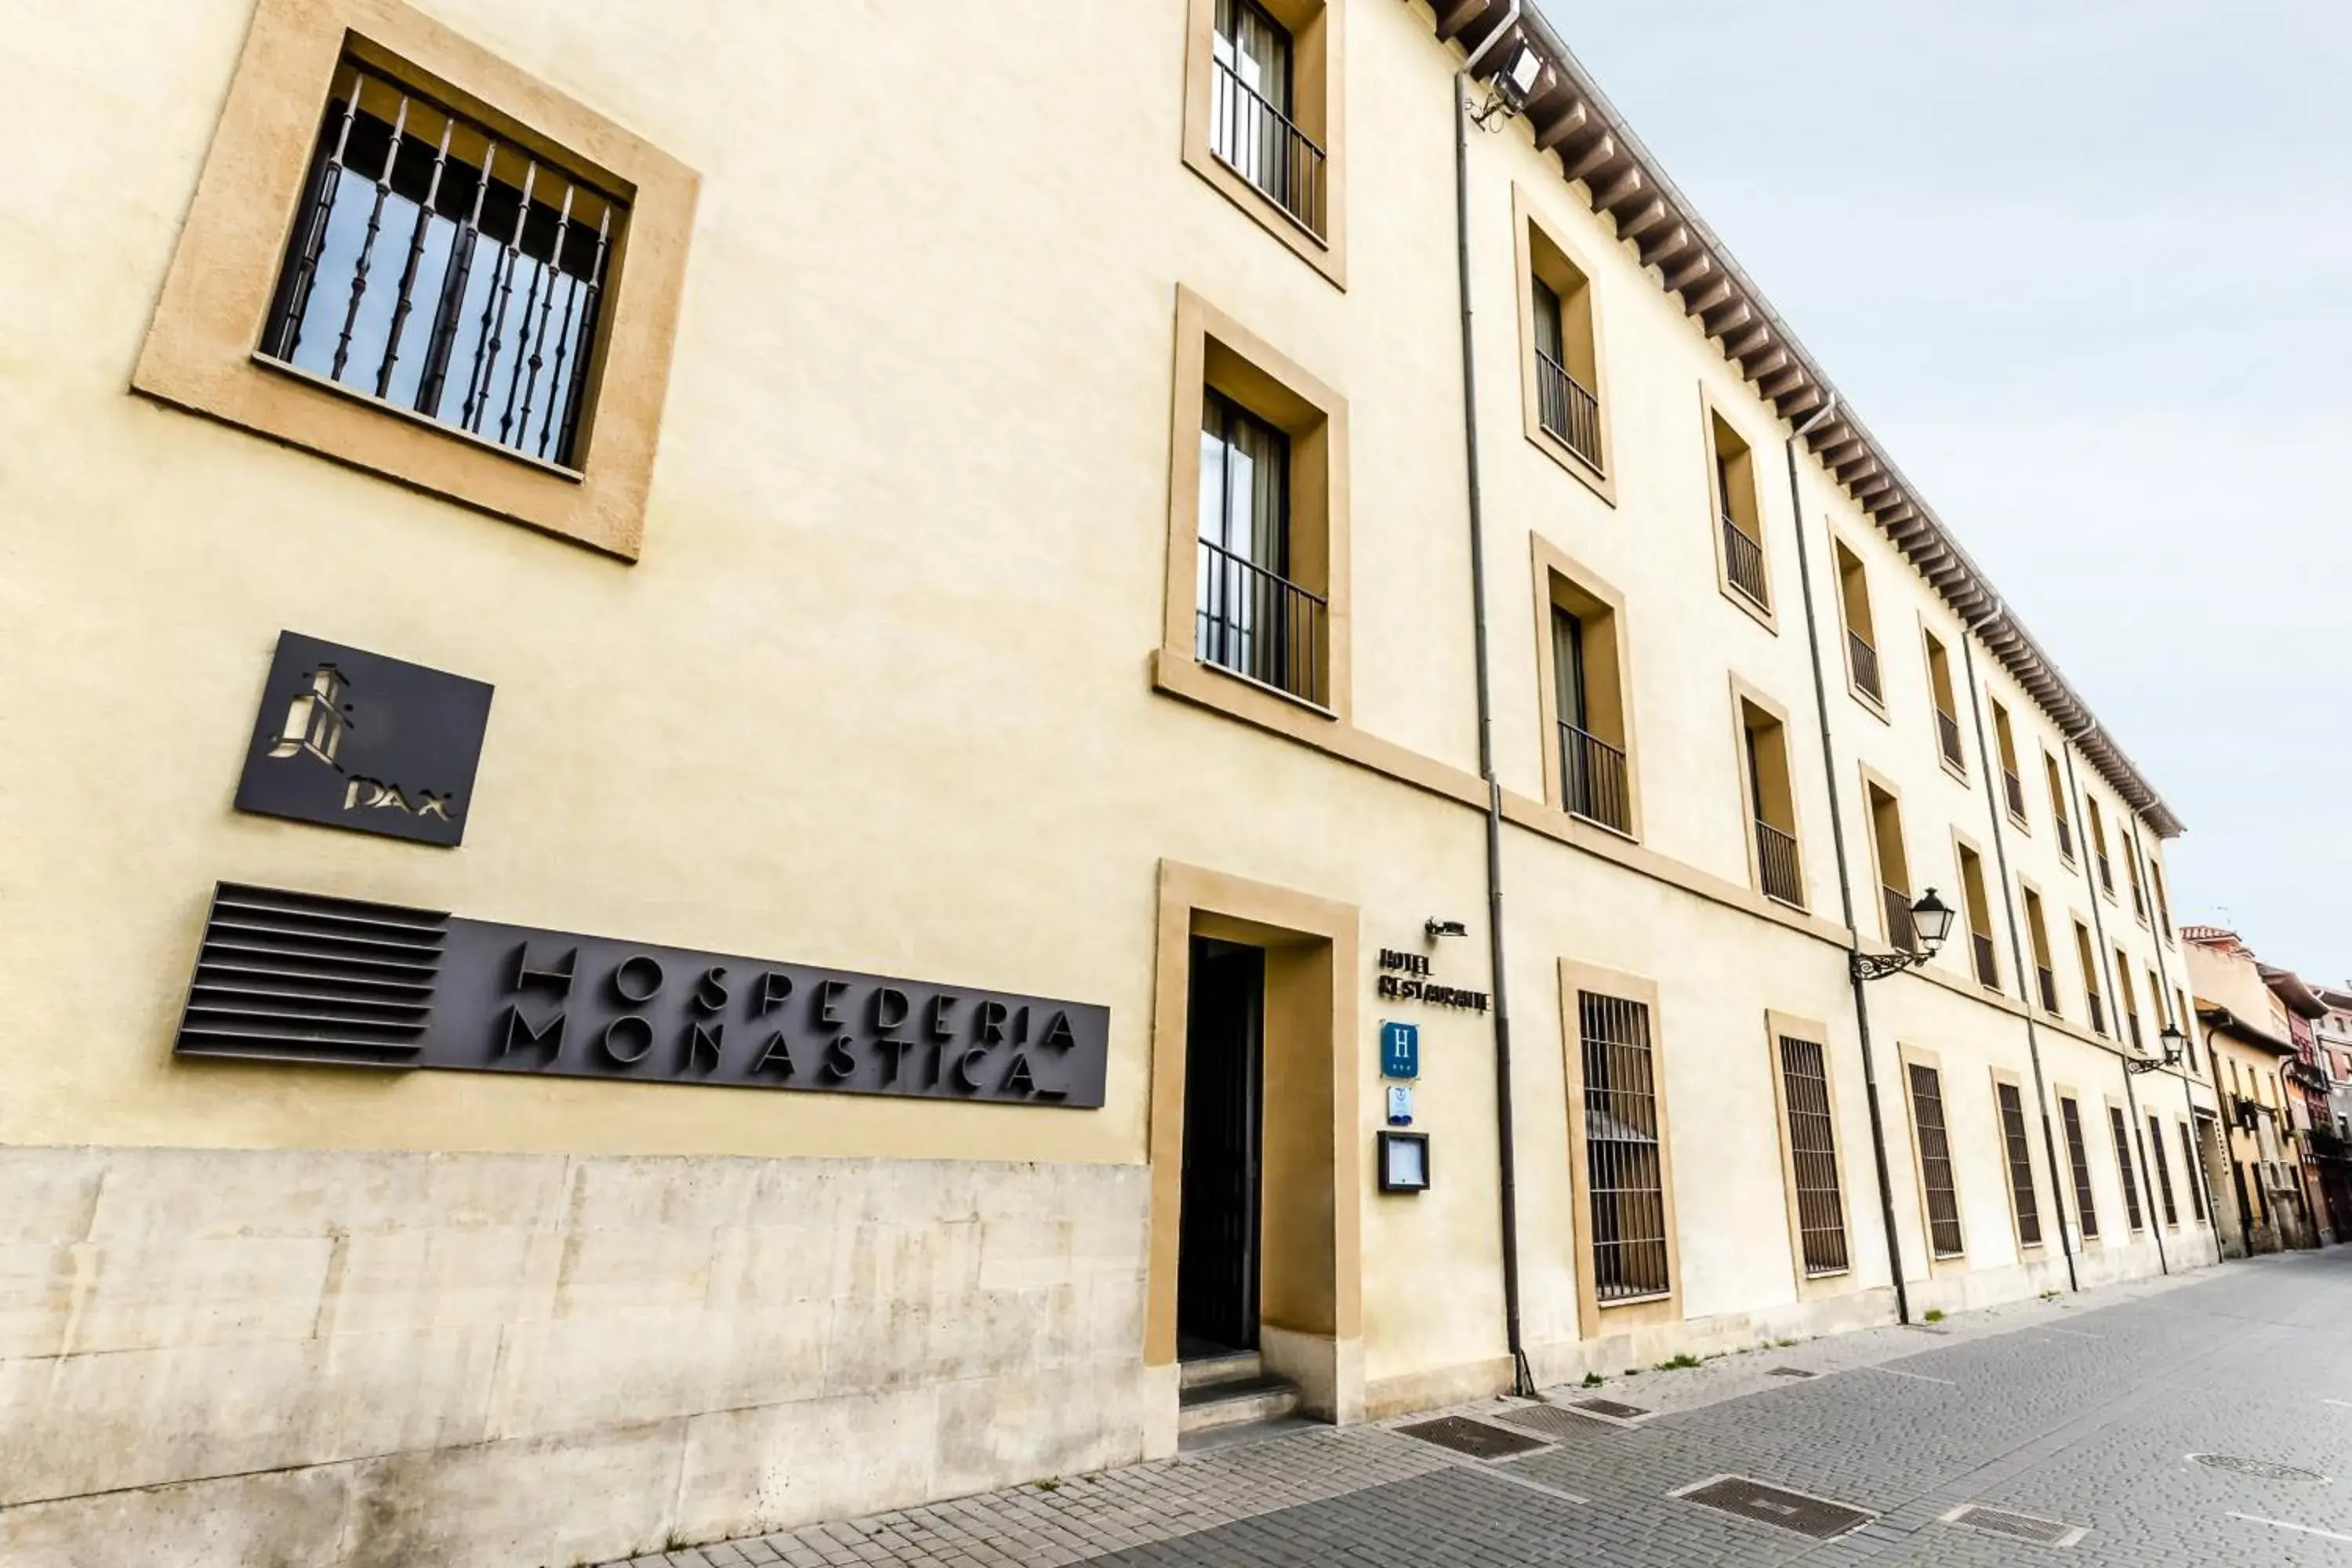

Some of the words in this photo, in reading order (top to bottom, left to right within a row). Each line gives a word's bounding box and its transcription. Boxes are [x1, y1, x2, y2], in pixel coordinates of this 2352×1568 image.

[344, 774, 459, 822] PAX
[1379, 949, 1434, 976] HOTEL
[513, 941, 1075, 1048] HOSPEDERIA
[1378, 975, 1491, 1011] RESTAURANTE
[1394, 1029, 1410, 1058] H
